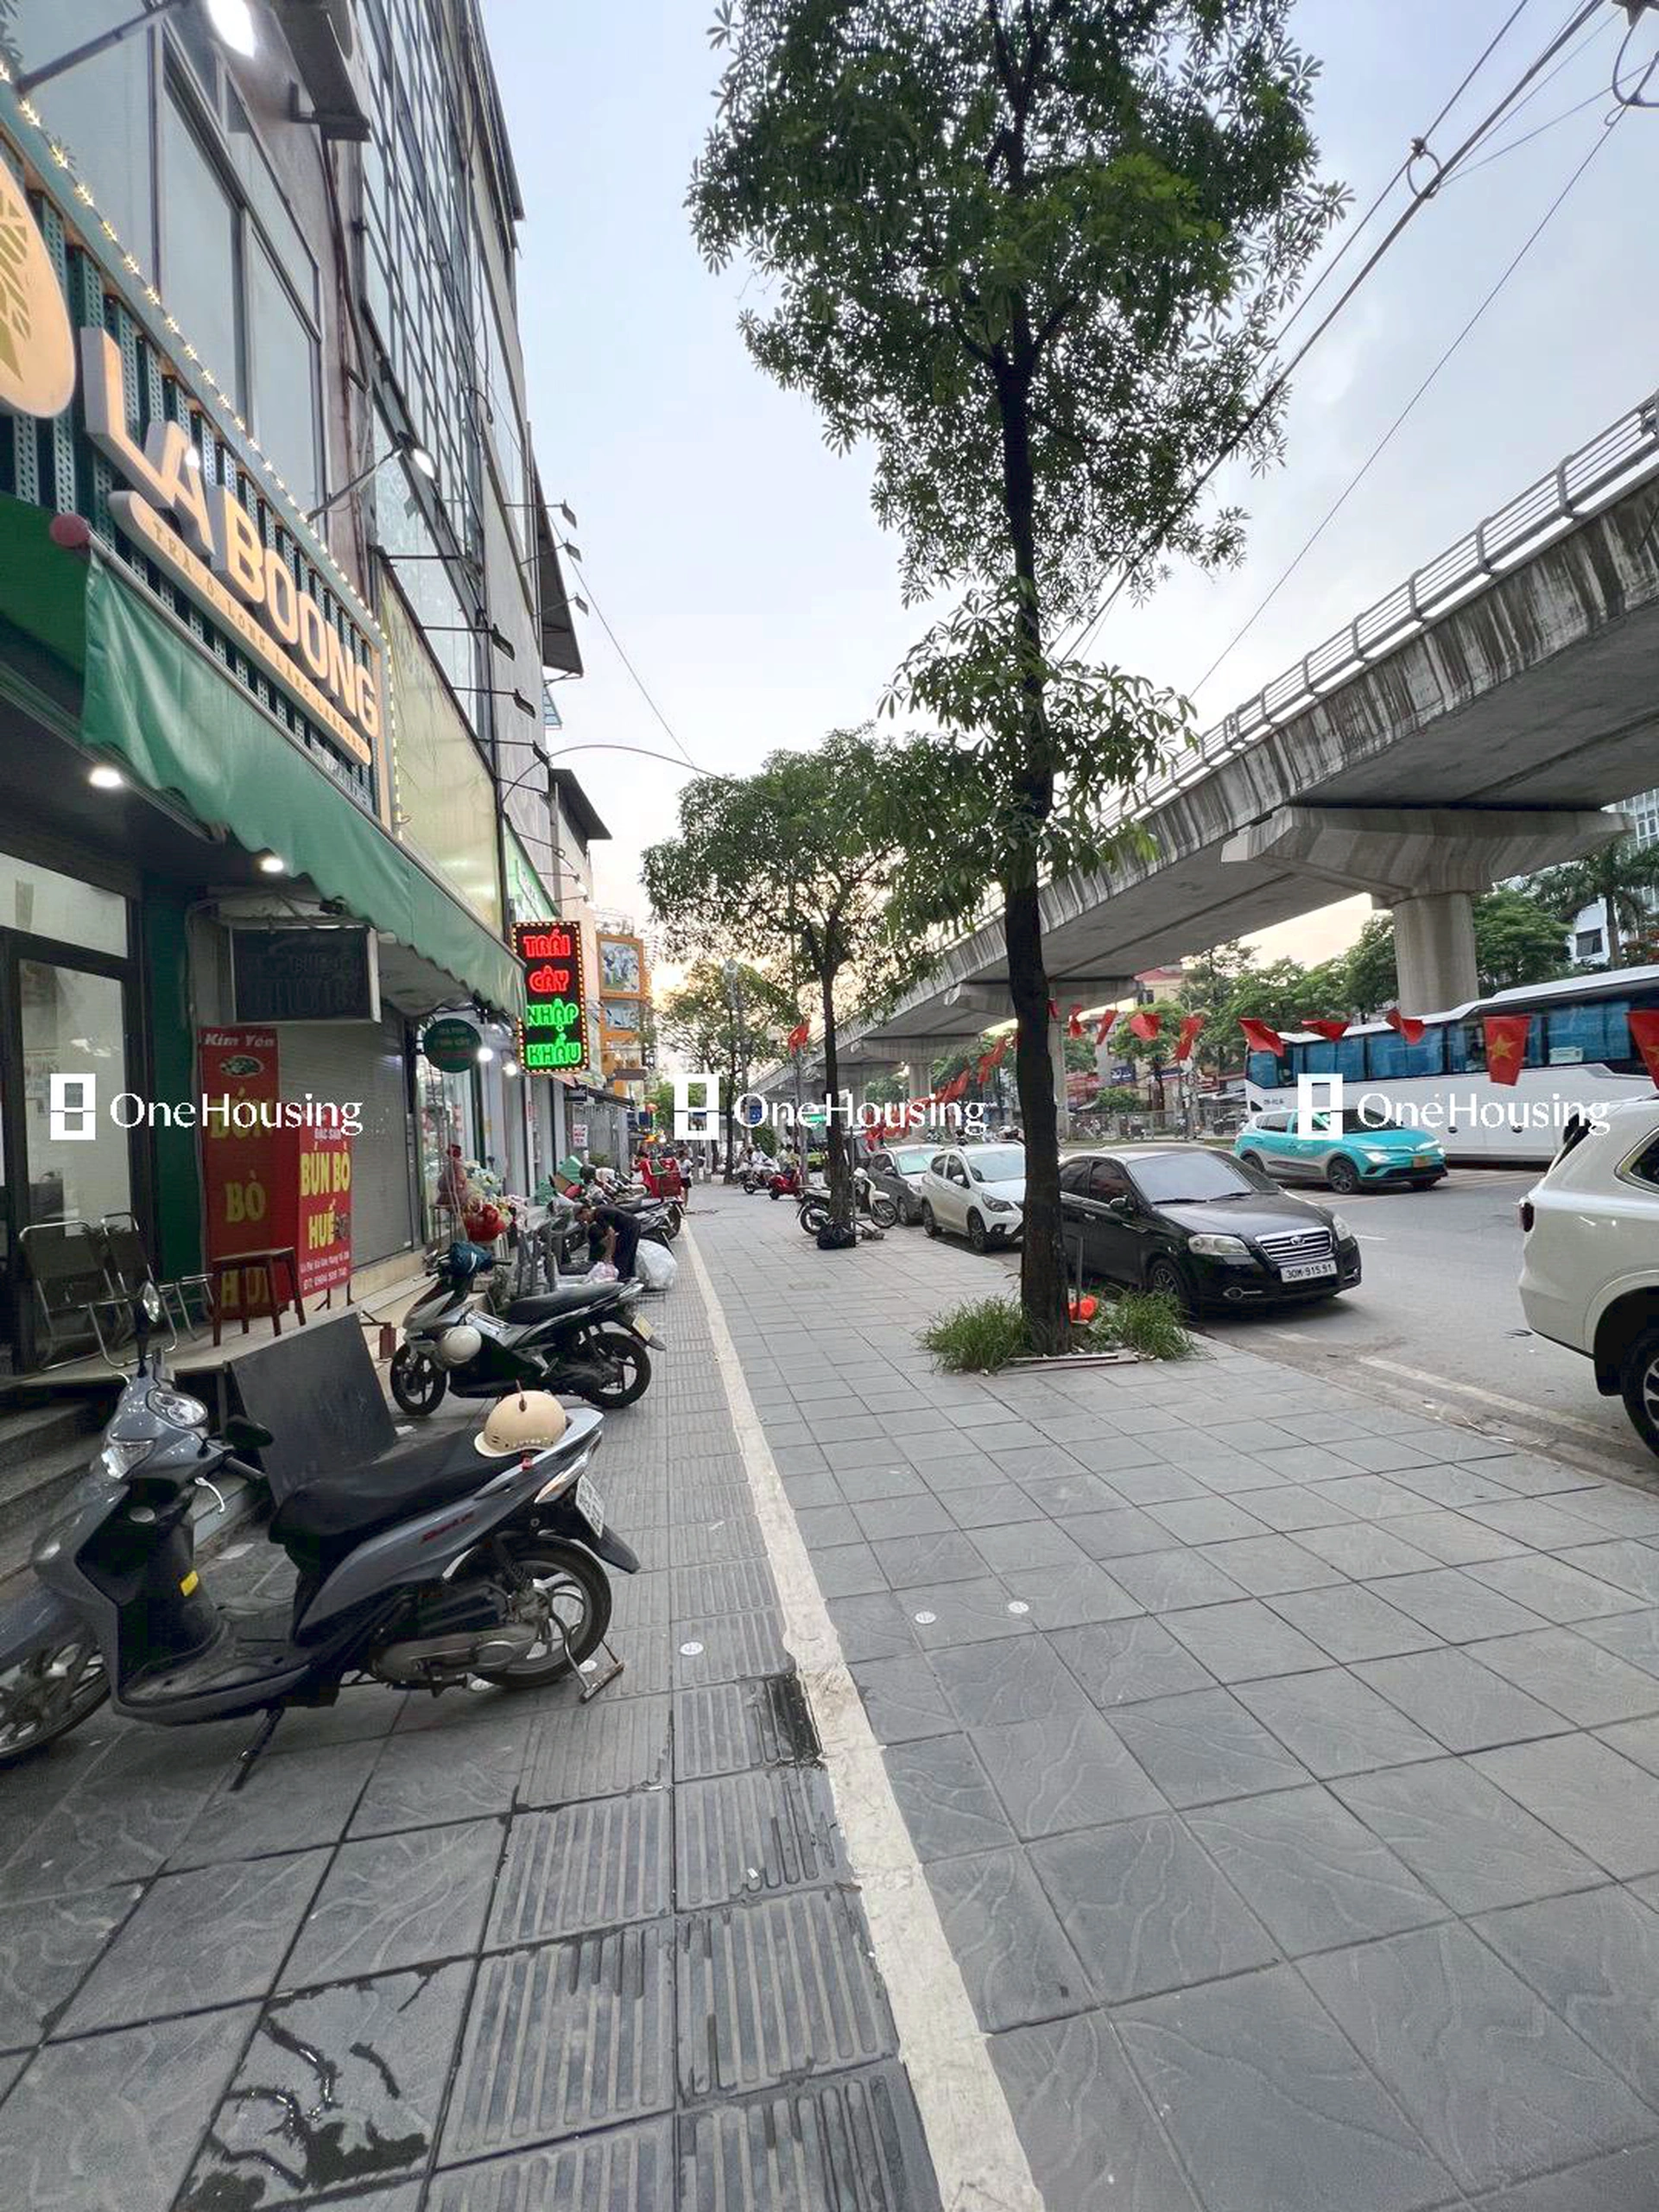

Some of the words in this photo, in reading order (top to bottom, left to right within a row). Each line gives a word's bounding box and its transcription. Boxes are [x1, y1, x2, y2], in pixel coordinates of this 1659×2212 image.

[523, 929, 571, 957] TRÁI
[529, 966, 569, 992] CÂY
[527, 998, 579, 1031] NHẬP
[205, 1034, 239, 1046] Kim
[527, 1032, 582, 1066] KHẨU
[301, 1142, 330, 1197] BÚN
[333, 1141, 351, 1193] BÒ
[225, 1172, 267, 1223] BÒ
[308, 1198, 336, 1251] HUẾ
